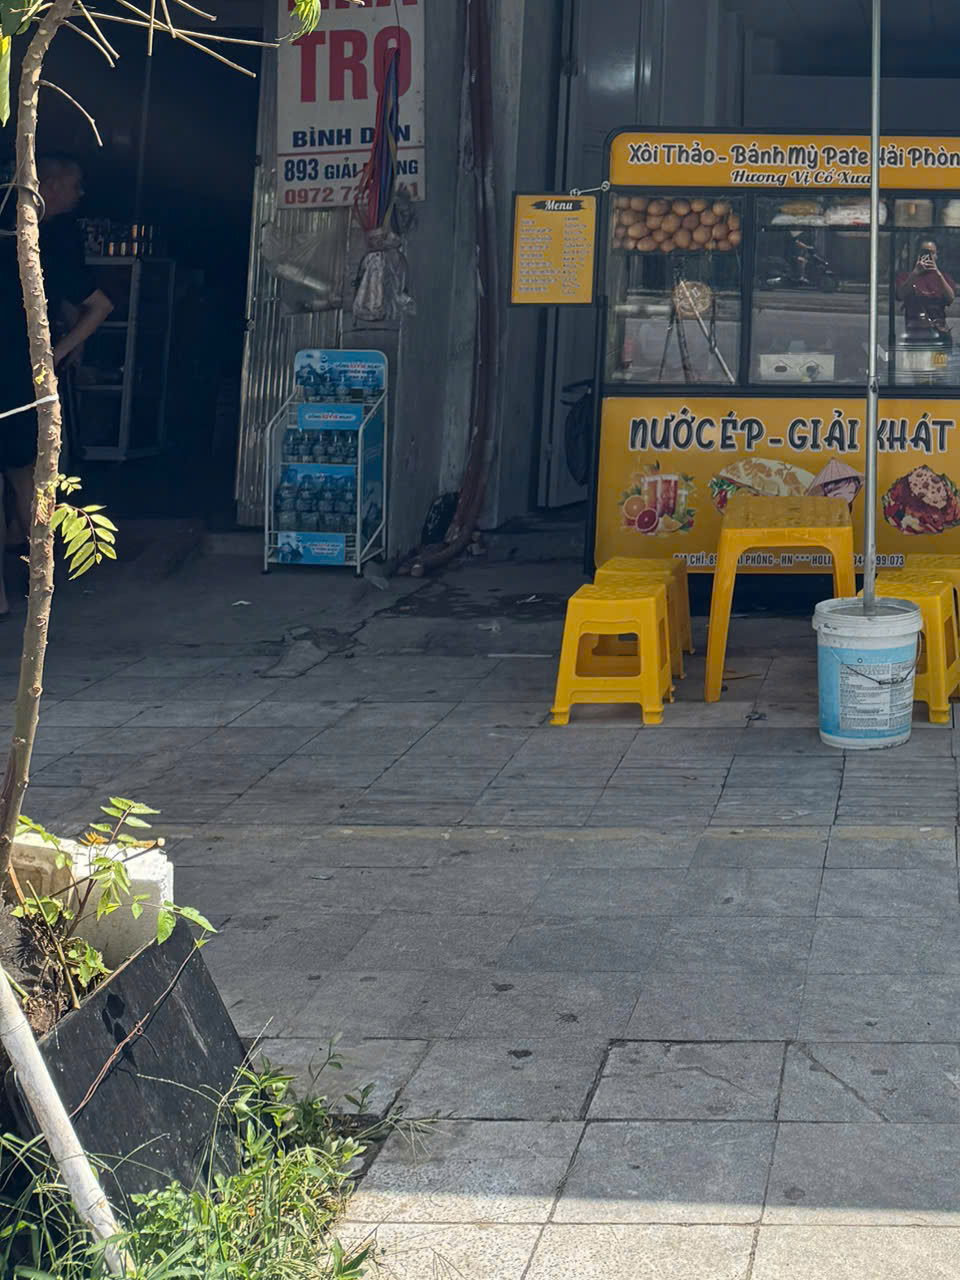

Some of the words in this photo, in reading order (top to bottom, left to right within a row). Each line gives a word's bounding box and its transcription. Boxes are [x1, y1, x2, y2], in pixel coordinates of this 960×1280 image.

[292, 126, 352, 148] BÌNH
[360, 124, 410, 144] DN
[628, 142, 659, 163] Xôi
[662, 141, 715, 164] Thảo
[730, 143, 785, 165] Bánh
[788, 145, 818, 169] Mỳ
[822, 145, 870, 166] Pate
[284, 158, 319, 181] 893
[284, 187, 334, 205] 0972
[544, 199, 573, 211] Menu
[787, 408, 859, 453] GIẢI
[781, 555, 793, 566] HN
